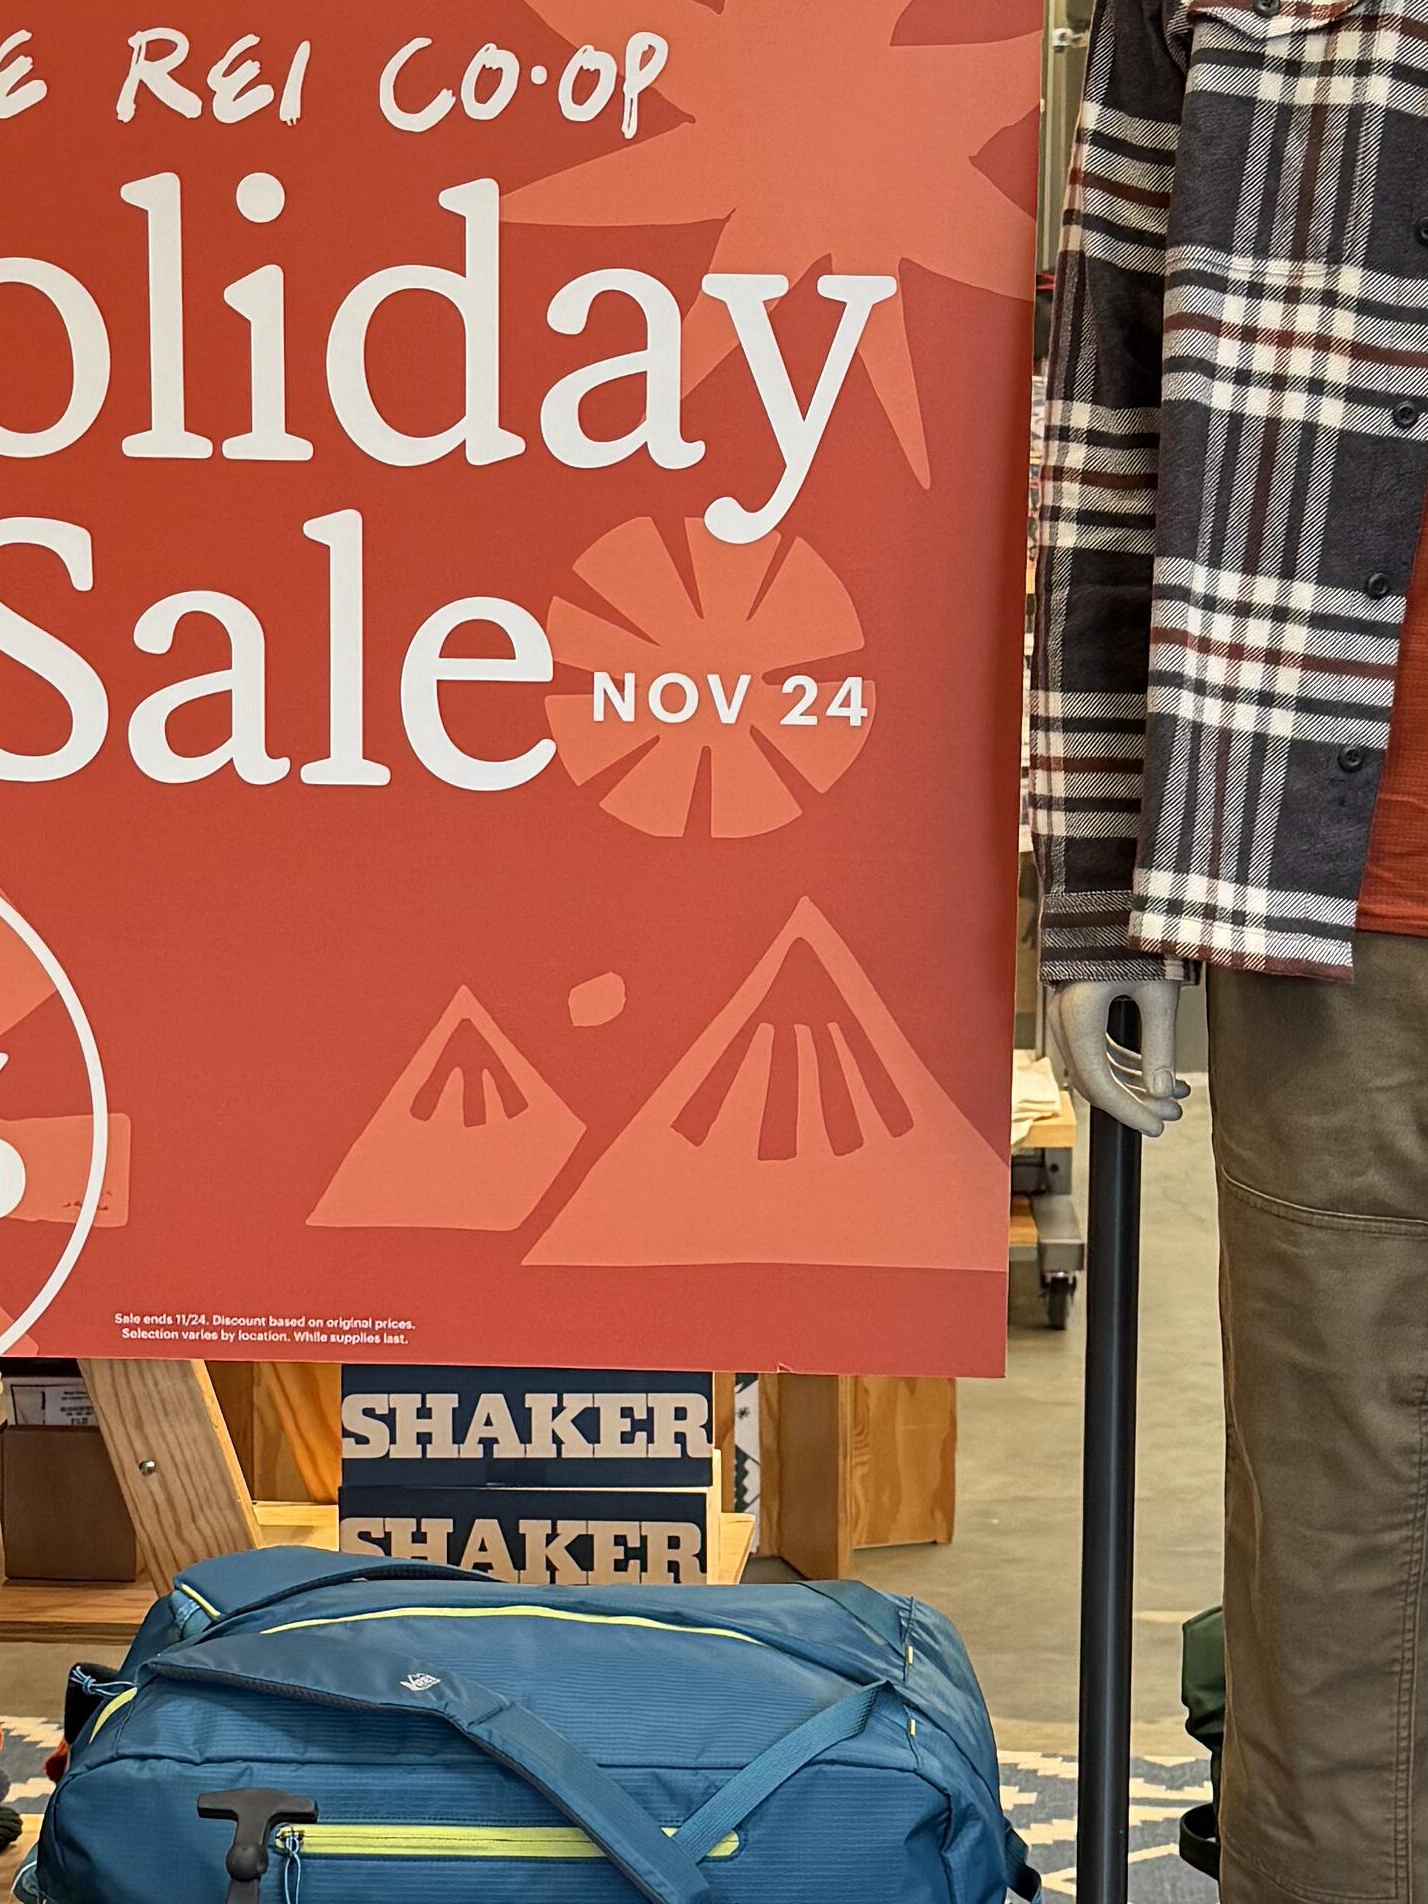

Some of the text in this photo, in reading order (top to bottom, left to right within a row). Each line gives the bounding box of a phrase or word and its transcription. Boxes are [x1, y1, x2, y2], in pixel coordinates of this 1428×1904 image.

[115, 27, 311, 126] REI
[593, 671, 869, 727] NOV 24
[115, 1312, 416, 1332] Sale ends 11/24. Discount based on original prices.
[121, 1328, 409, 1345] Selection varies by location. While supplies last.
[339, 1389, 714, 1462] SHAKER
